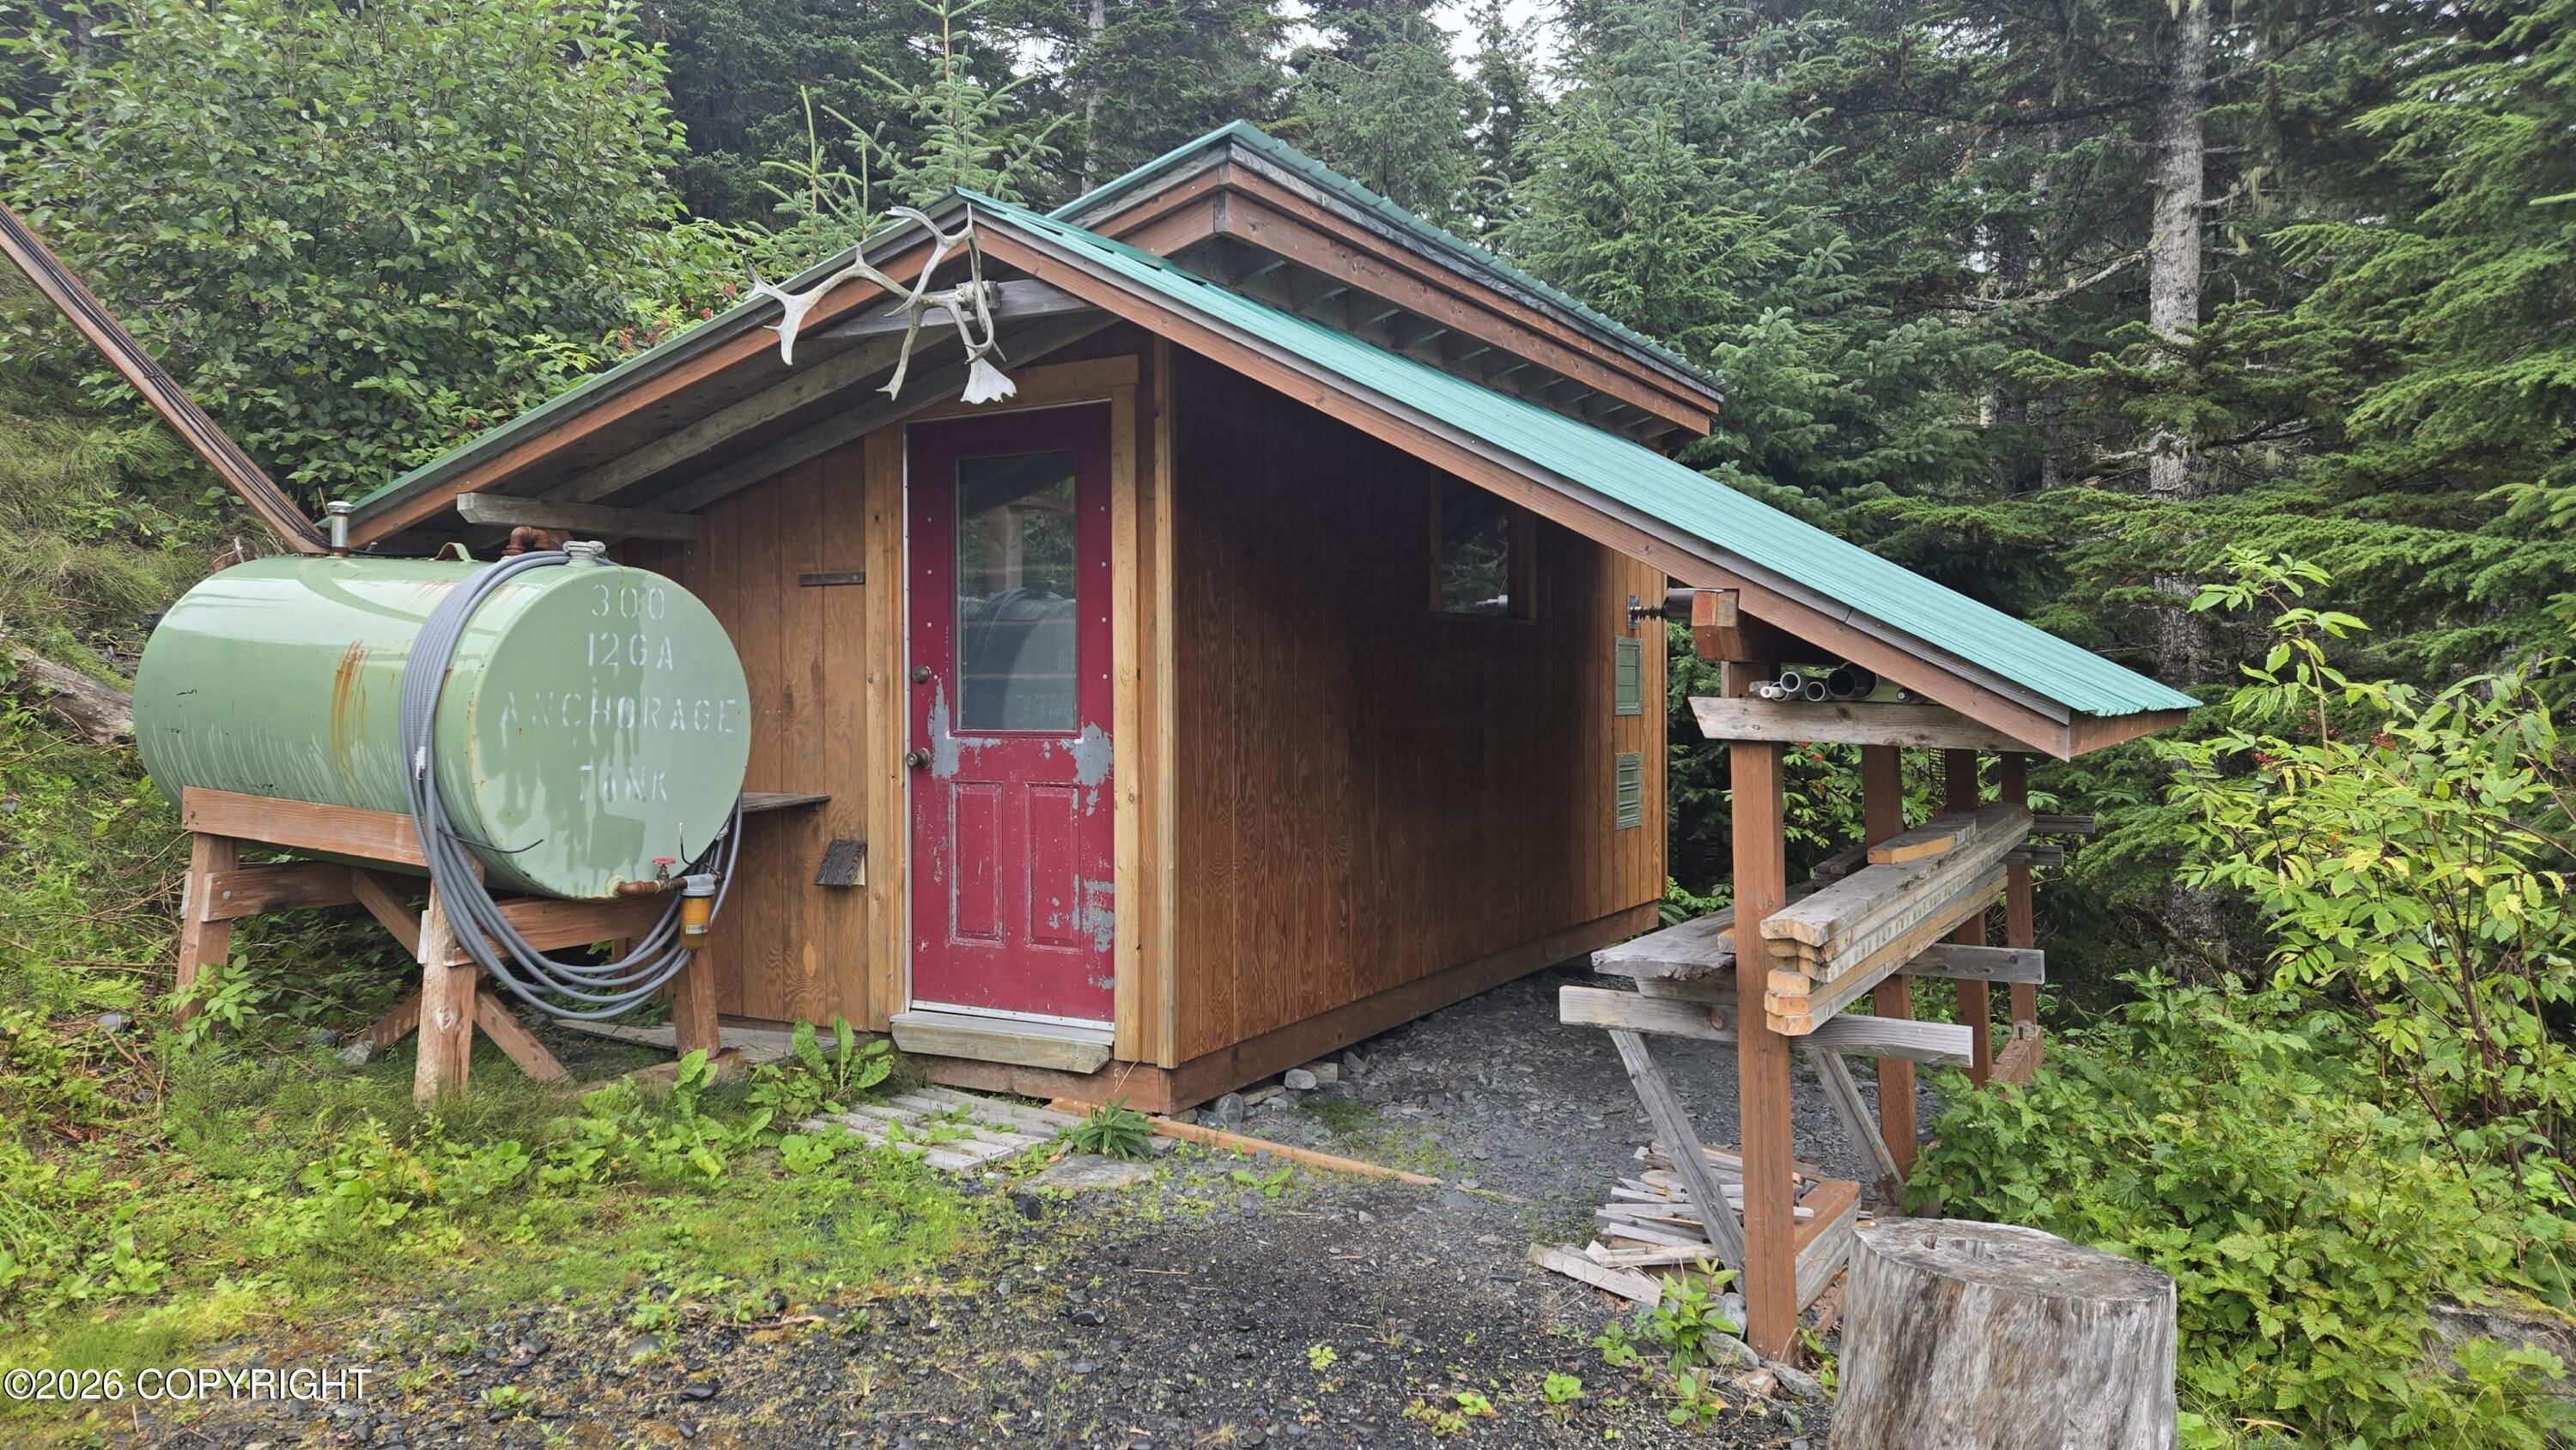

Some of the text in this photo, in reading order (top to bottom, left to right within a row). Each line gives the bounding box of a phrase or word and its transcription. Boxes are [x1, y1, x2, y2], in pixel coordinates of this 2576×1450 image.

[591, 584, 665, 620] 300
[500, 690, 737, 733] ANCHORAGE
[579, 764, 668, 803] TANK
